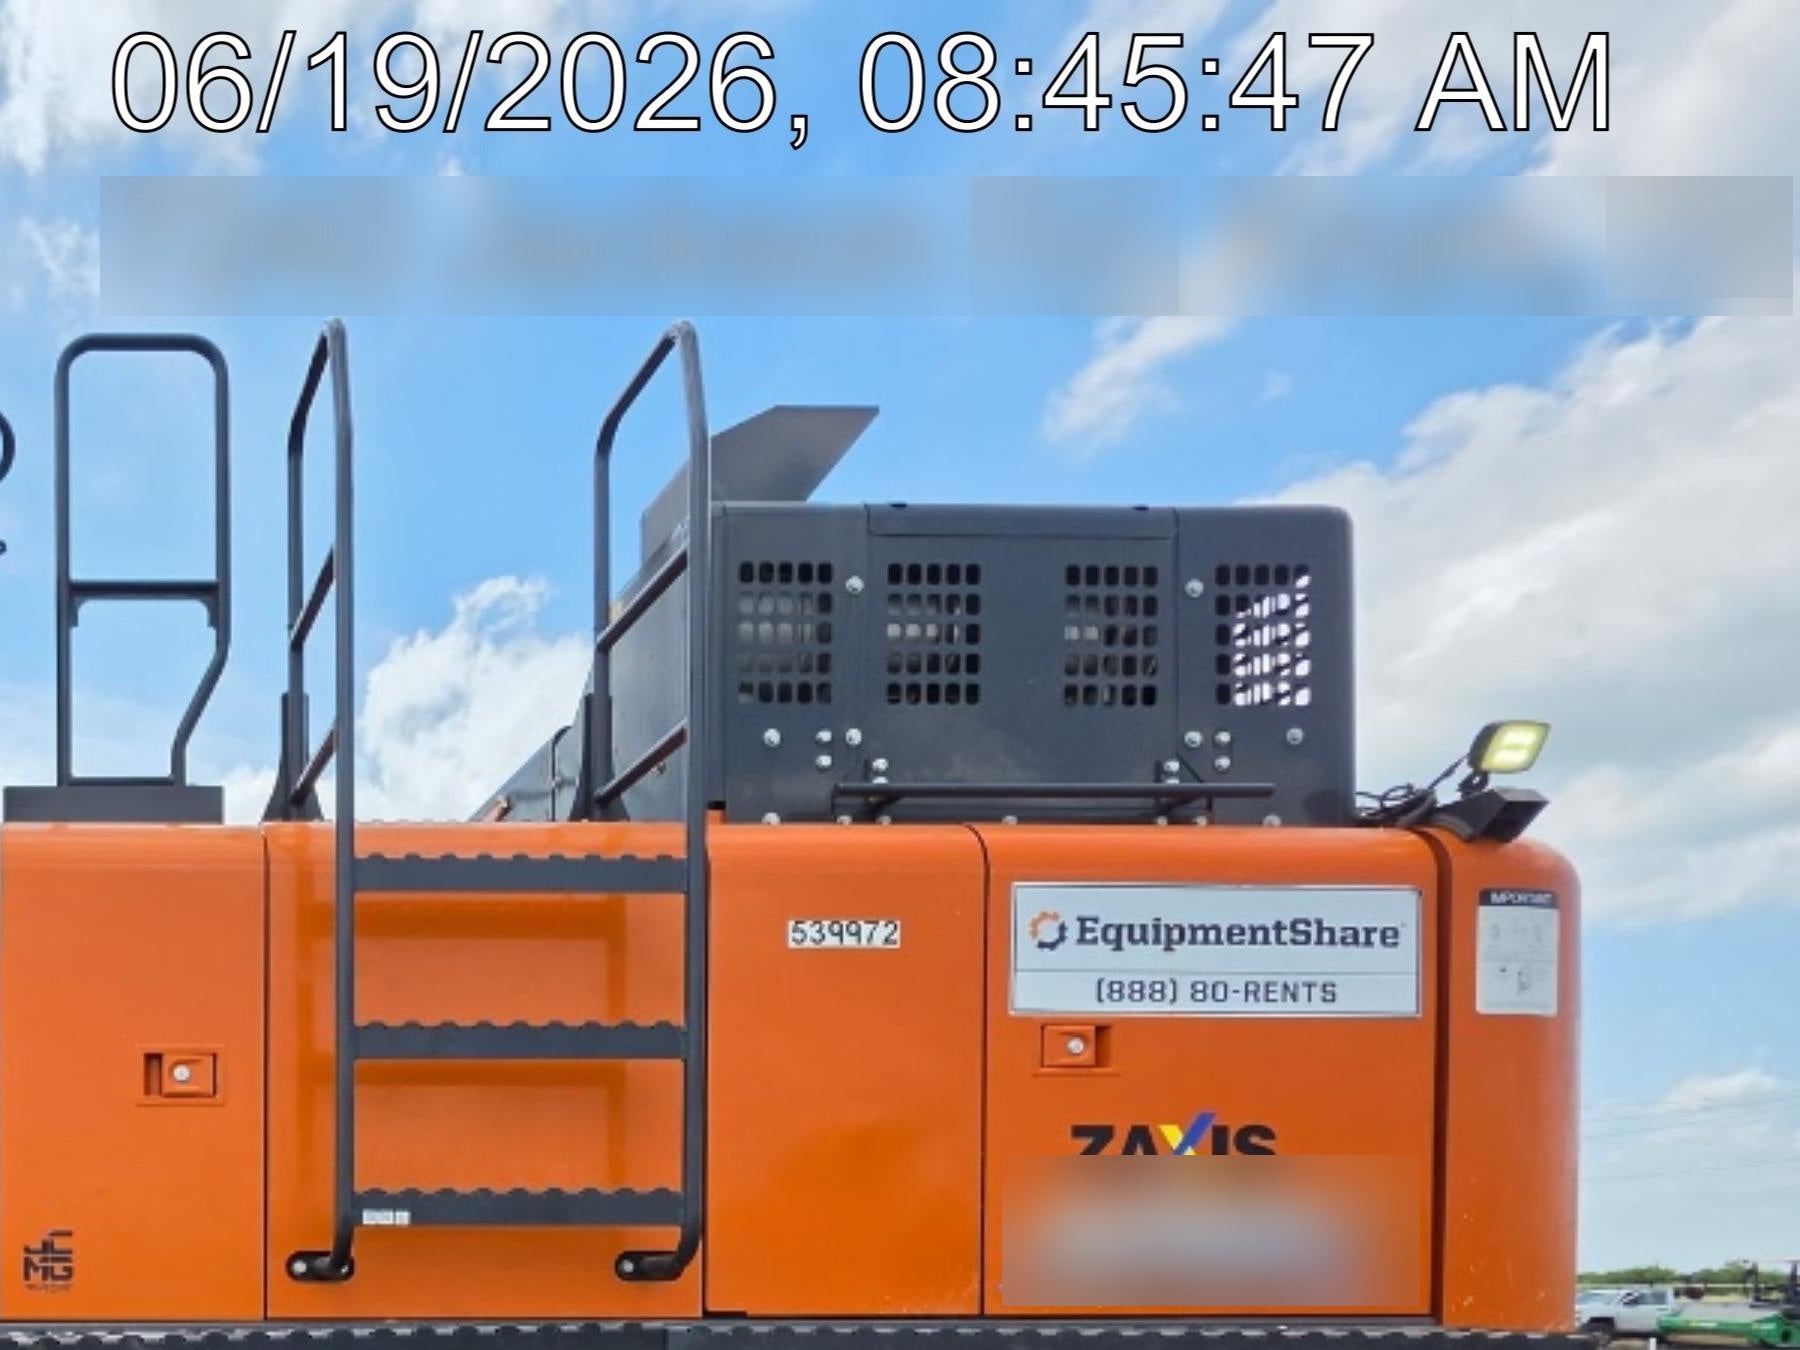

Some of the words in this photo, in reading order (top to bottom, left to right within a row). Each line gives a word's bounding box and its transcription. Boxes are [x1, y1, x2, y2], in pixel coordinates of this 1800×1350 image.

[791, 920, 898, 945] 539972
[1075, 915, 1400, 952] EquipmentShare
[1097, 977, 1177, 1003] (888)
[1189, 980, 1338, 1004] 80-RENTS
